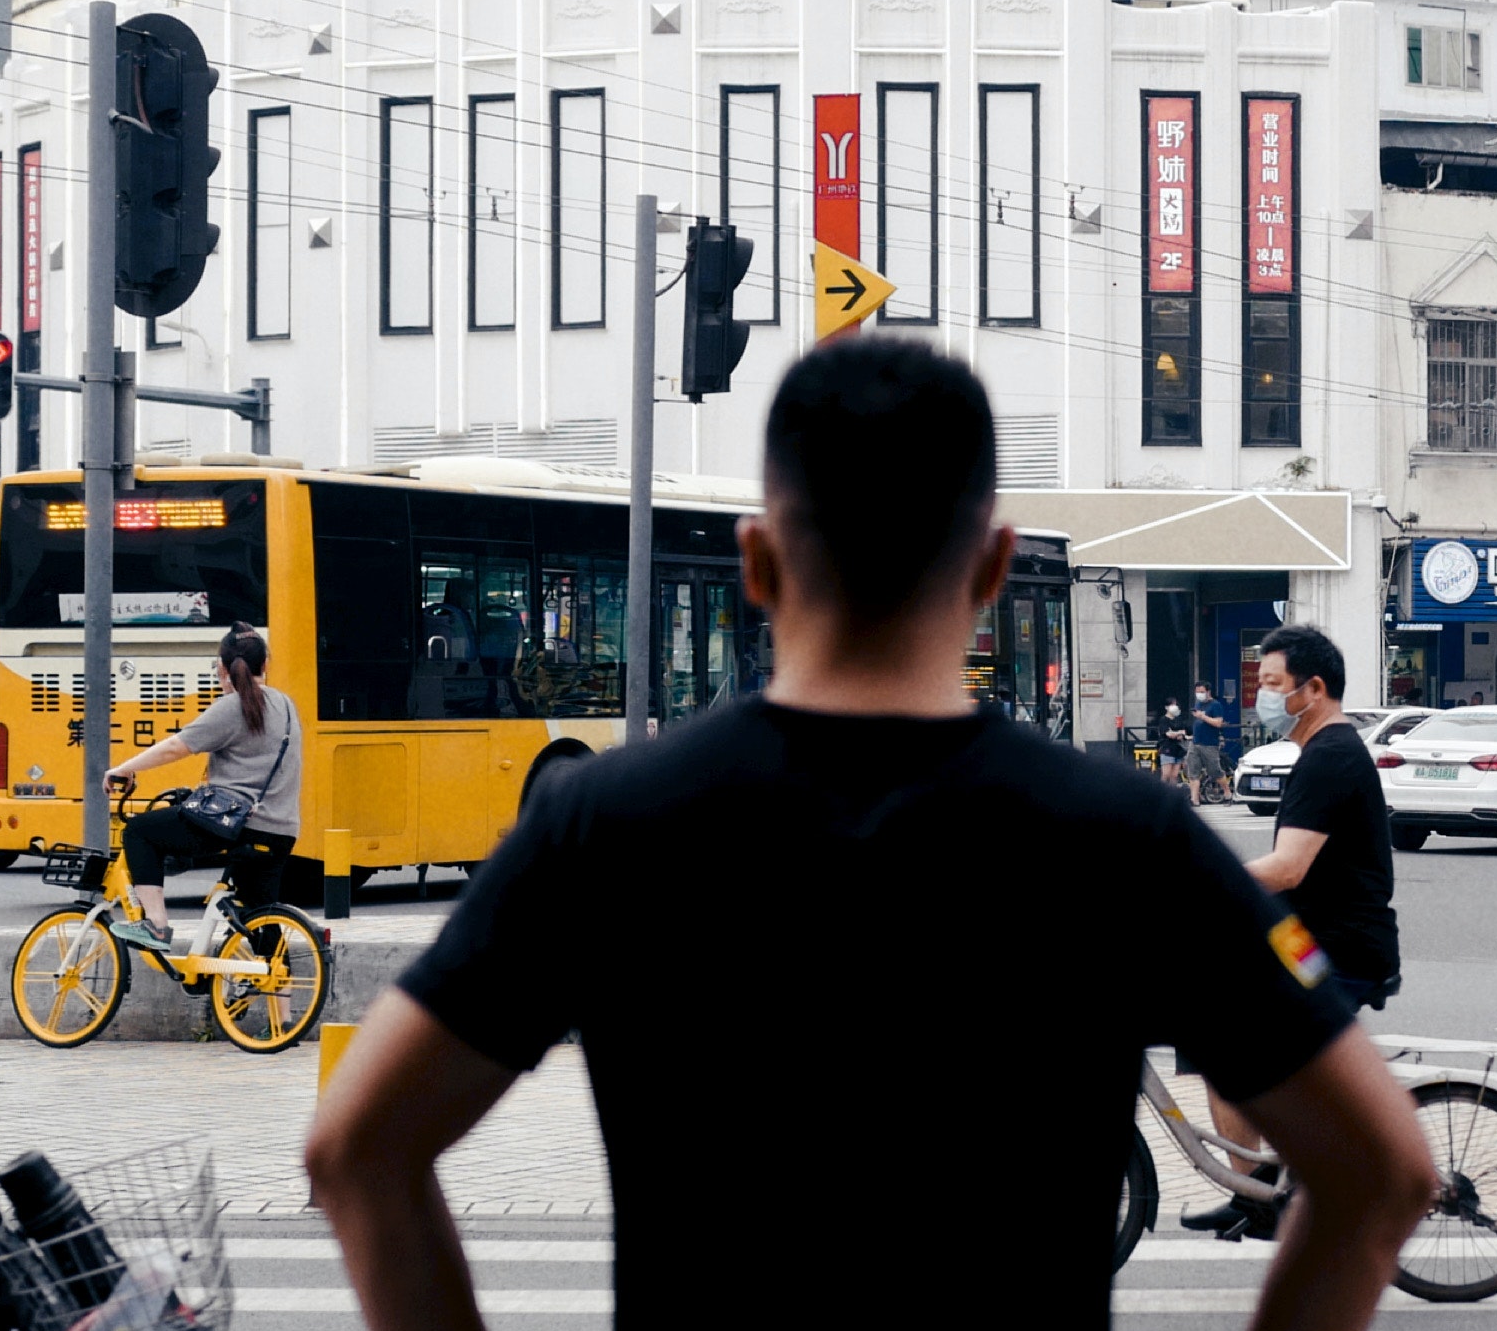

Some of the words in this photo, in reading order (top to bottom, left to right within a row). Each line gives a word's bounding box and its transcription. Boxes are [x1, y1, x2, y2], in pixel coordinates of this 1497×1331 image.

[1261, 112, 1280, 184] 营业时间
[1256, 194, 1285, 209] 上午
[1159, 251, 1183, 271] 2F
